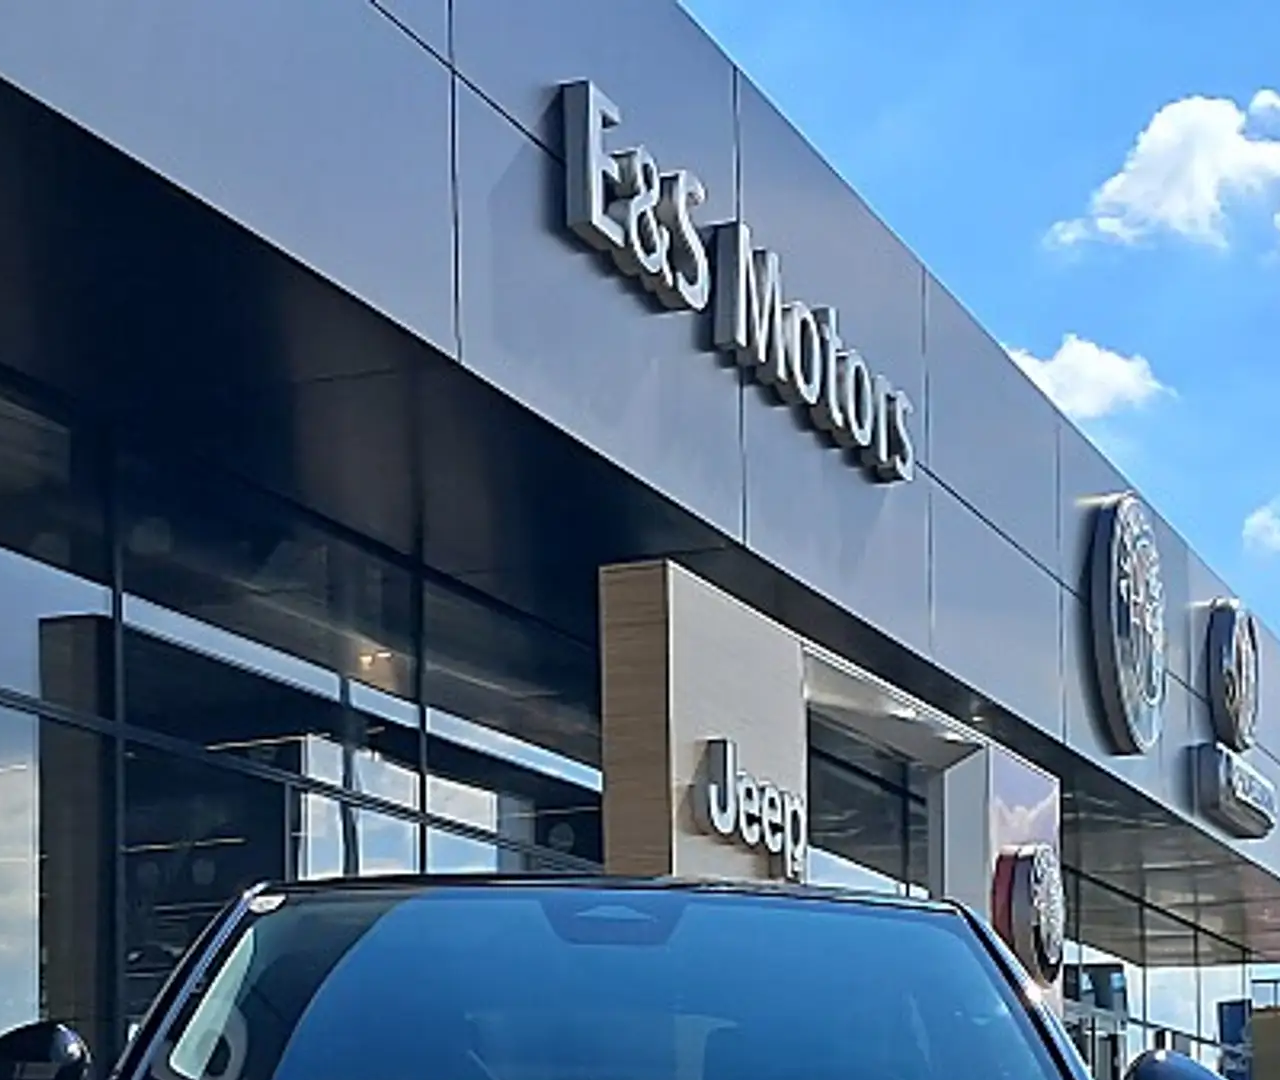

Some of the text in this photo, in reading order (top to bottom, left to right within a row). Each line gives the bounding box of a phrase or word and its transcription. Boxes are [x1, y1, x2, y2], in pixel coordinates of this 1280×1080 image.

[562, 80, 914, 482] E&S Motors
[706, 738, 807, 882] Jeep
